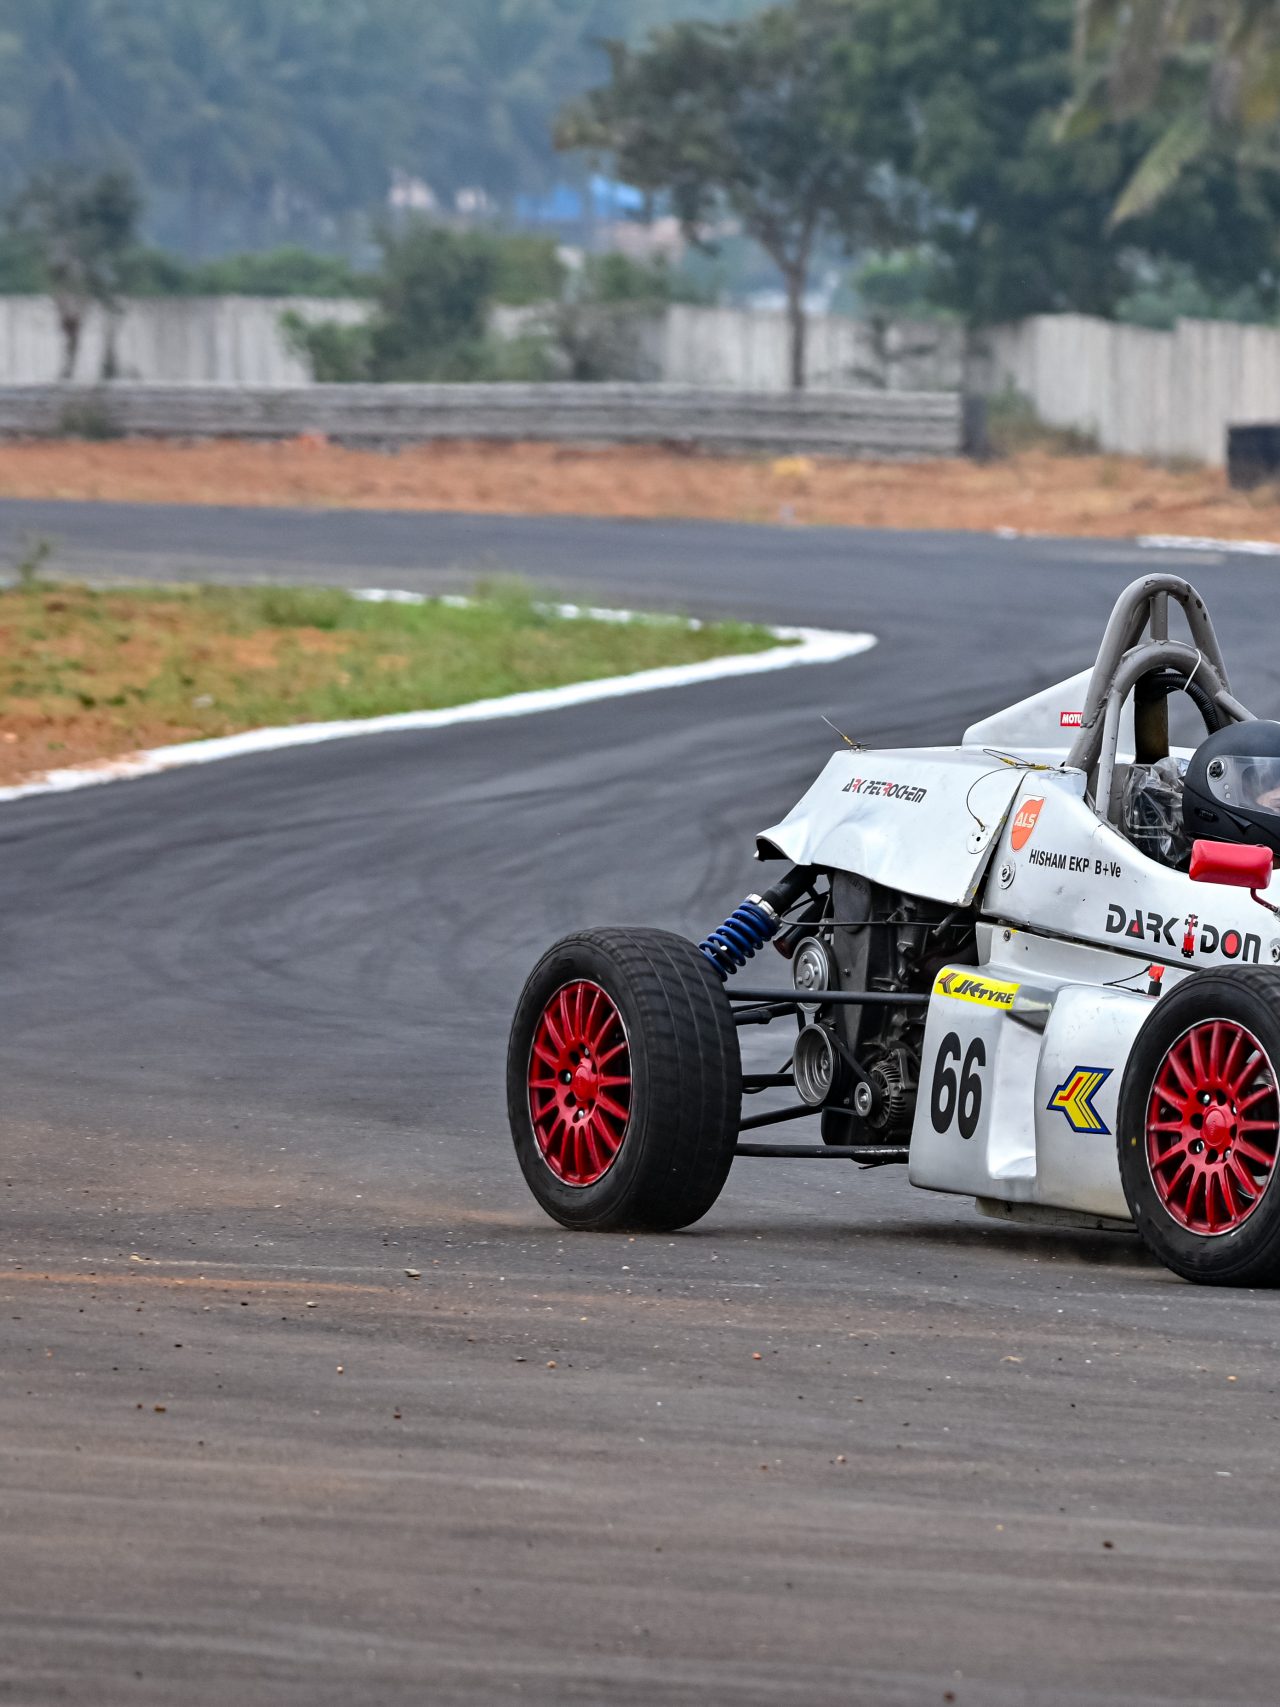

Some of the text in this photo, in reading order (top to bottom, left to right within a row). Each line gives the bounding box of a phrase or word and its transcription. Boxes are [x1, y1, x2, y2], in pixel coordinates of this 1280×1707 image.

[1061, 713, 1083, 725] MOTU
[863, 780, 928, 803] PETROCHEM
[1014, 812, 1037, 829] ALS
[1029, 849, 1067, 870] HISHAM
[1069, 856, 1089, 872] EKP
[930, 1031, 986, 1139] 66
